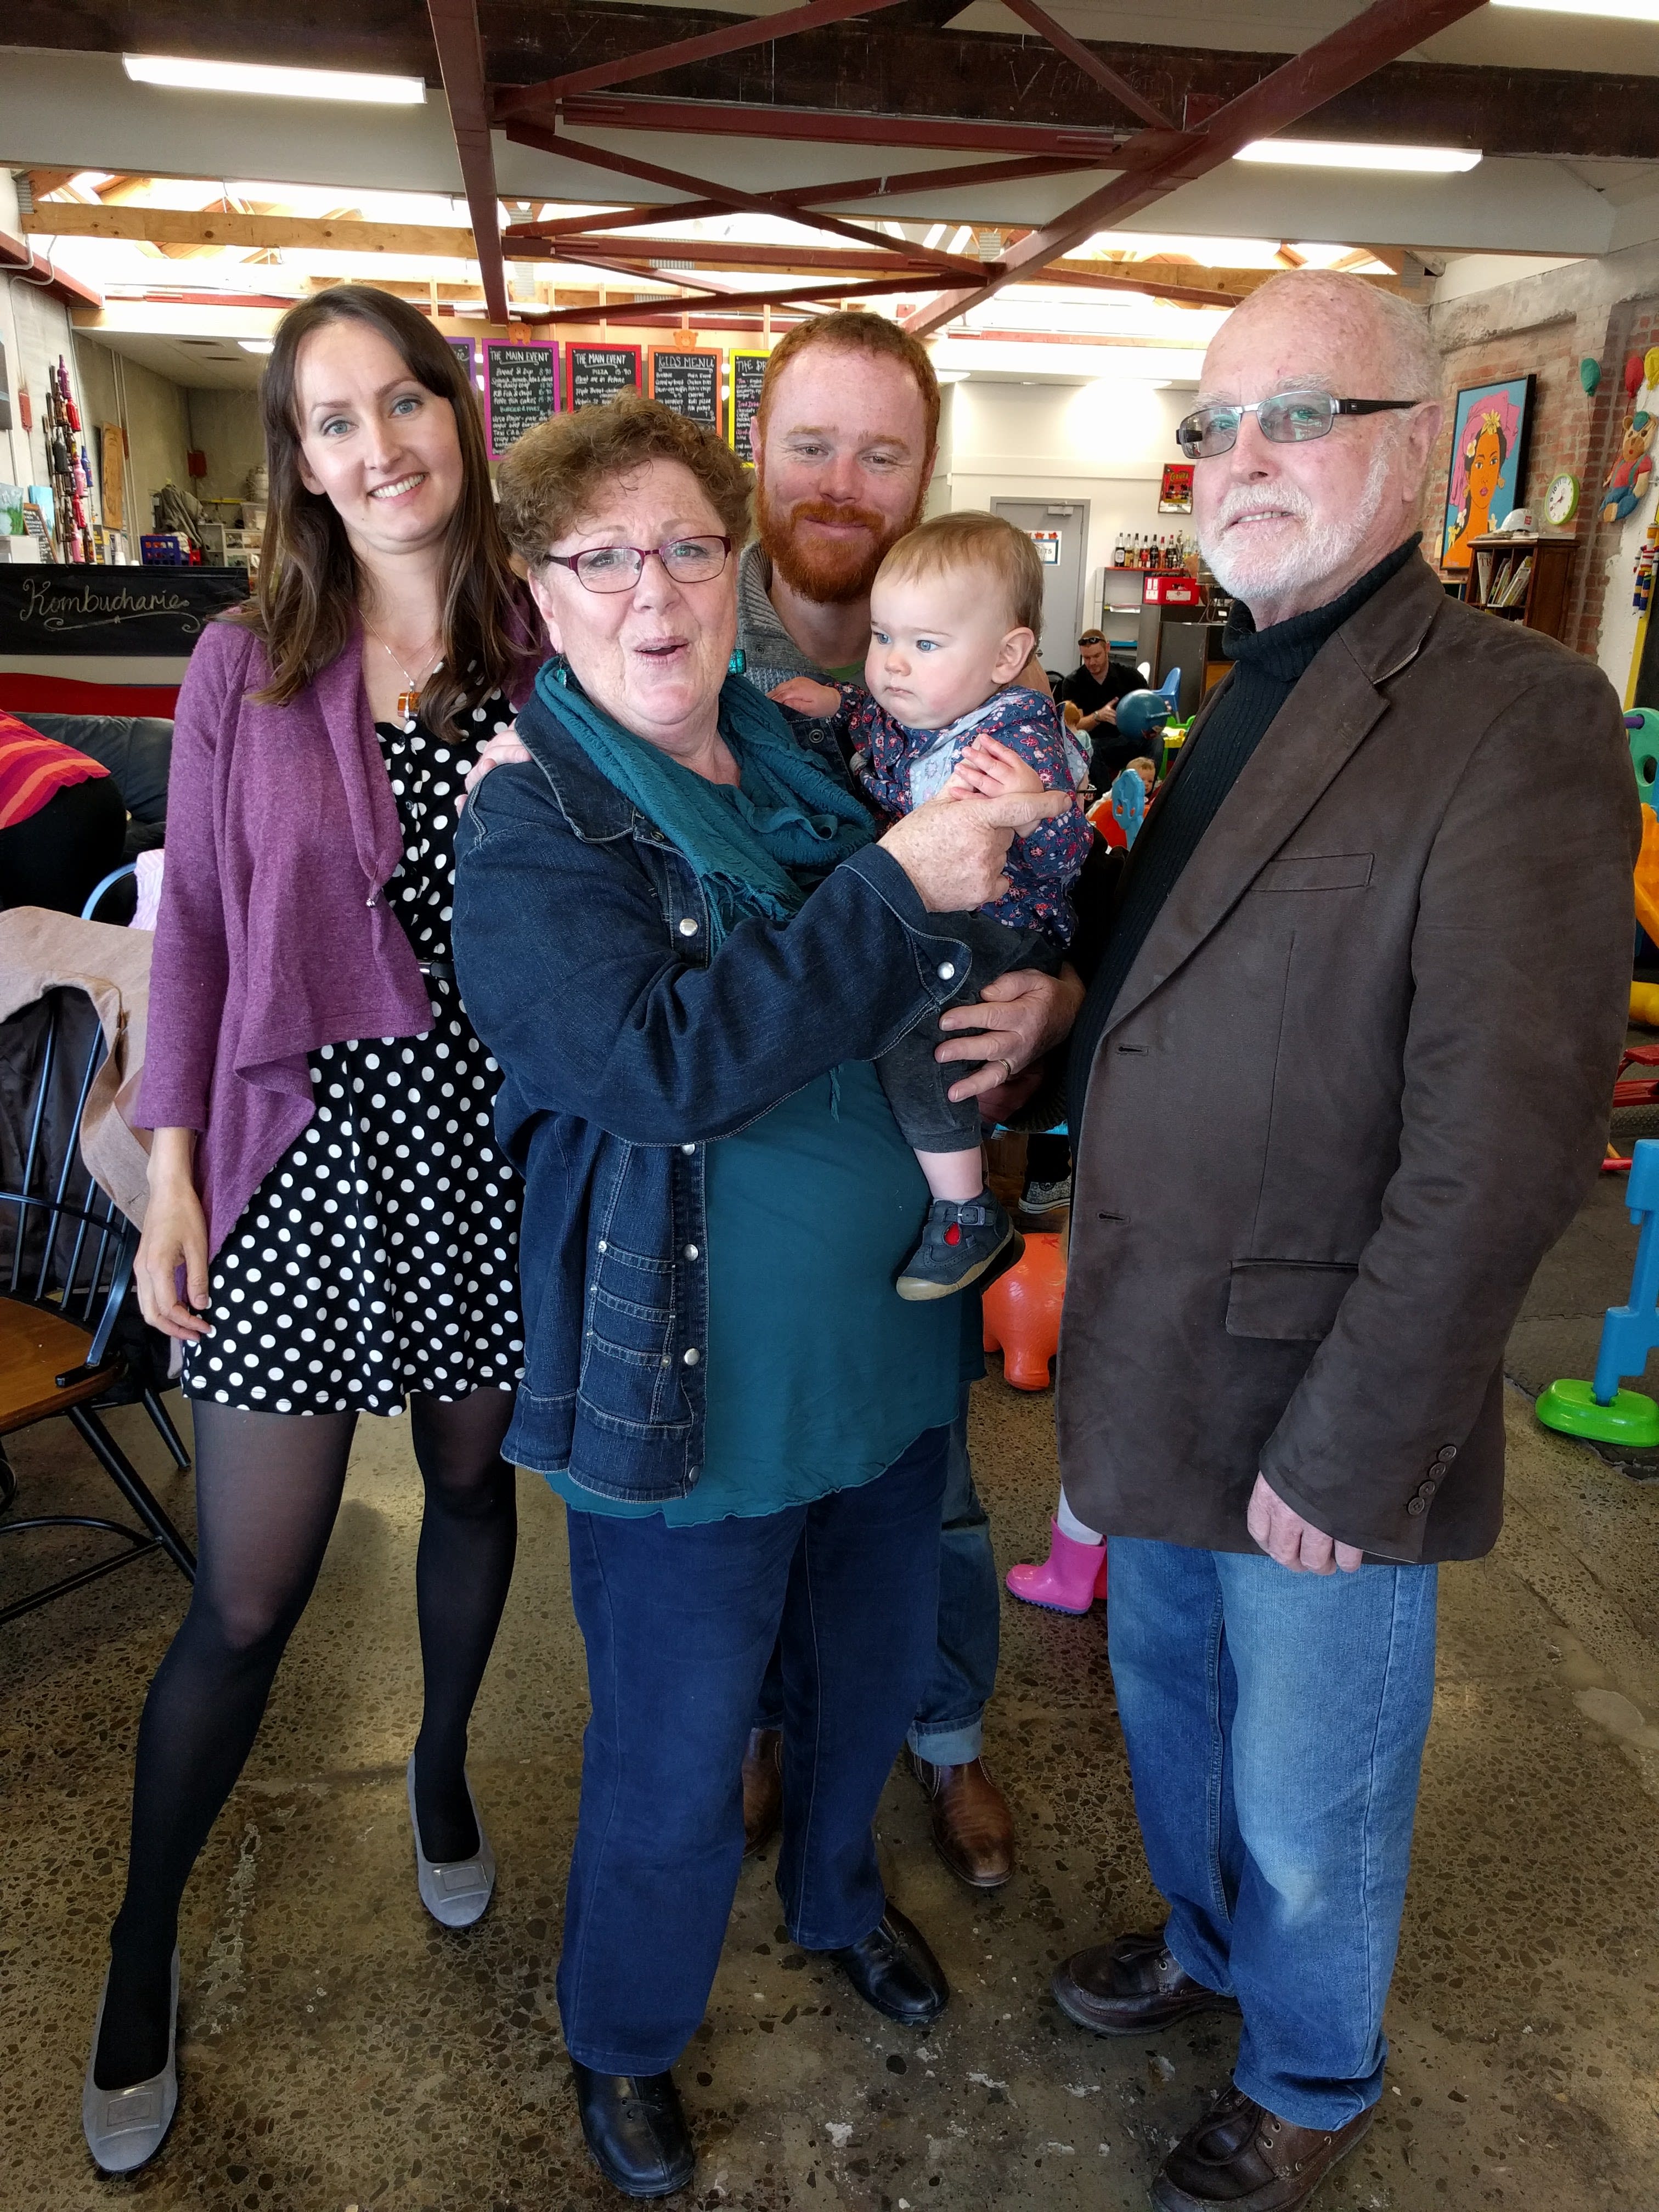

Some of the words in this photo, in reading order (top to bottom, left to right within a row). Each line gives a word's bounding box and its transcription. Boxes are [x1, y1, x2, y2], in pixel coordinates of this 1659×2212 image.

[490, 351, 501, 362] THE
[506, 351, 524, 361] MAIN
[526, 352, 549, 362] EVENT
[575, 353, 586, 365] THE
[589, 353, 605, 364] MAIN
[606, 354, 626, 365] EVENT
[659, 355, 681, 368] KIDS
[684, 357, 714, 368] MENU
[736, 360, 753, 373] THE
